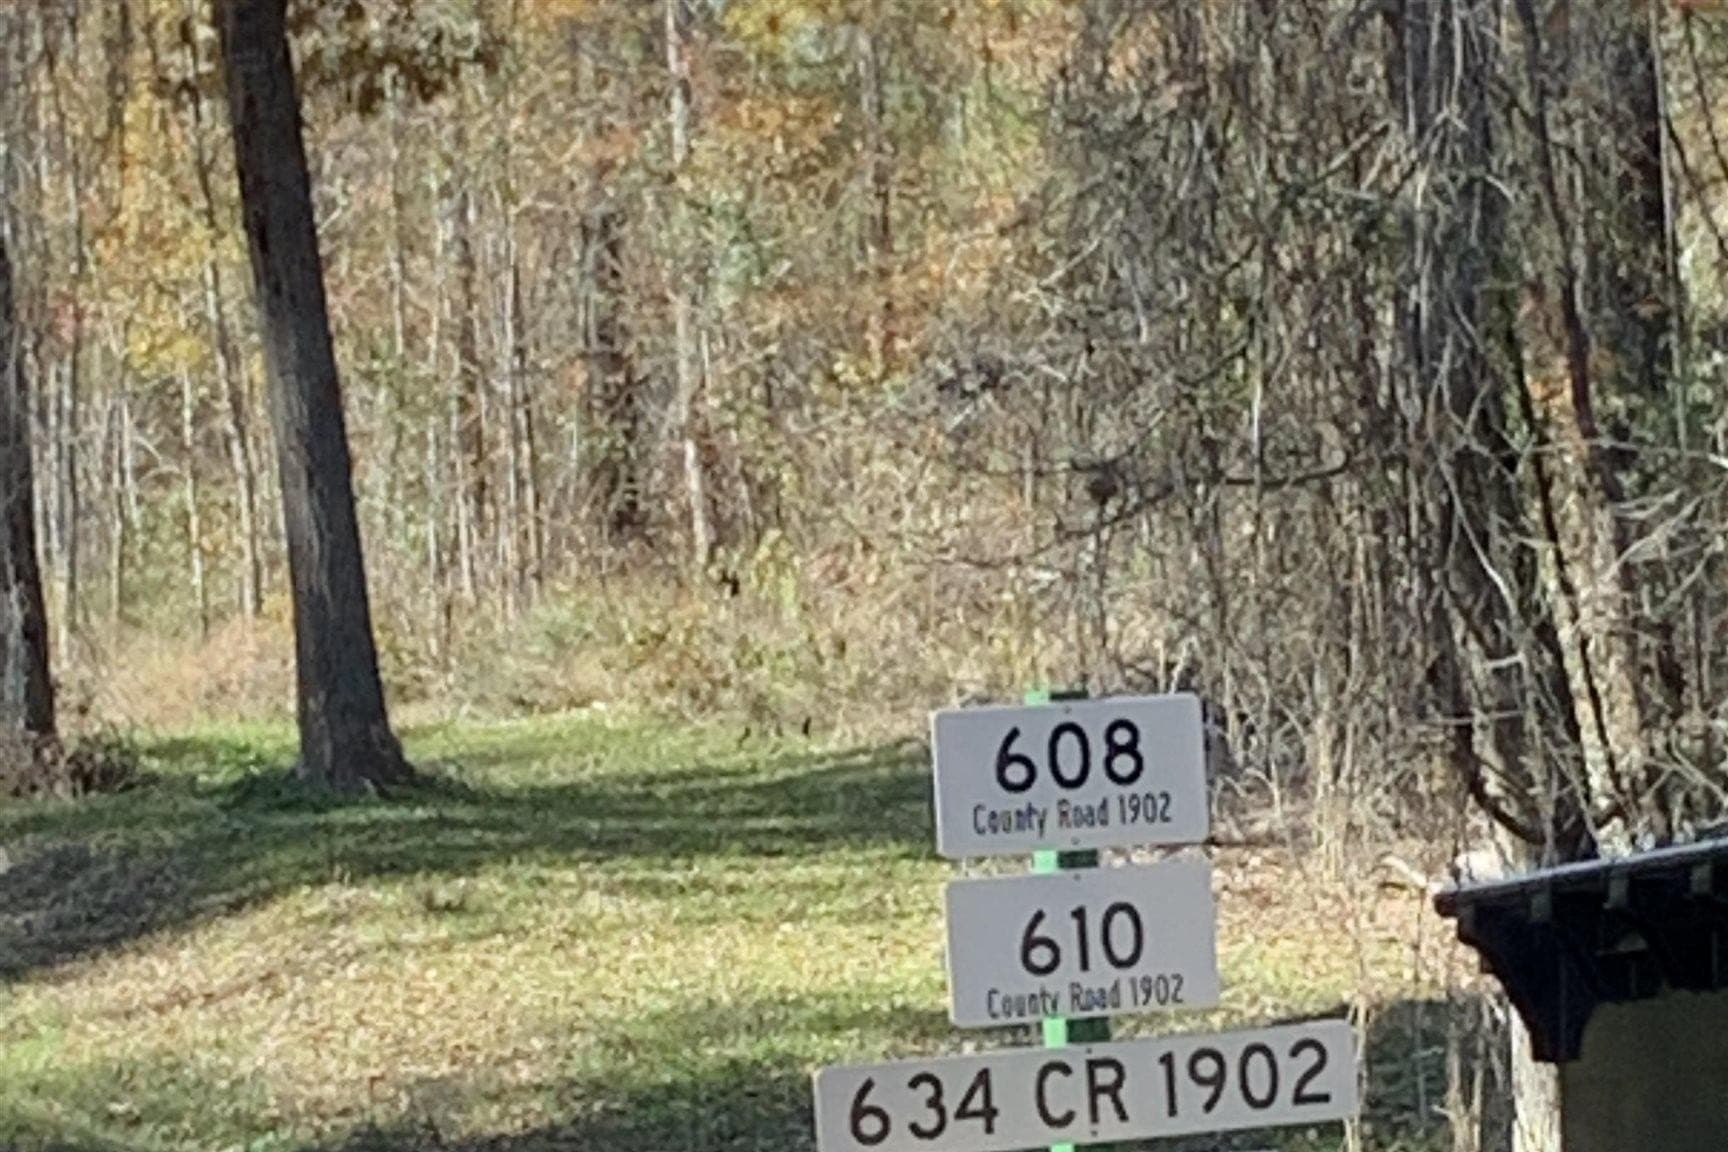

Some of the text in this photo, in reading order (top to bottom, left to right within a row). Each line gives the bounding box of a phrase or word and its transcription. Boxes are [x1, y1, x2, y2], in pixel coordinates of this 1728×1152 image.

[995, 719, 1144, 794] 608
[973, 791, 1173, 836] County Road 1902
[1020, 901, 1144, 977] 610
[987, 973, 1184, 1019] County Road 1902
[849, 1037, 1332, 1147] 634 CR 1902
